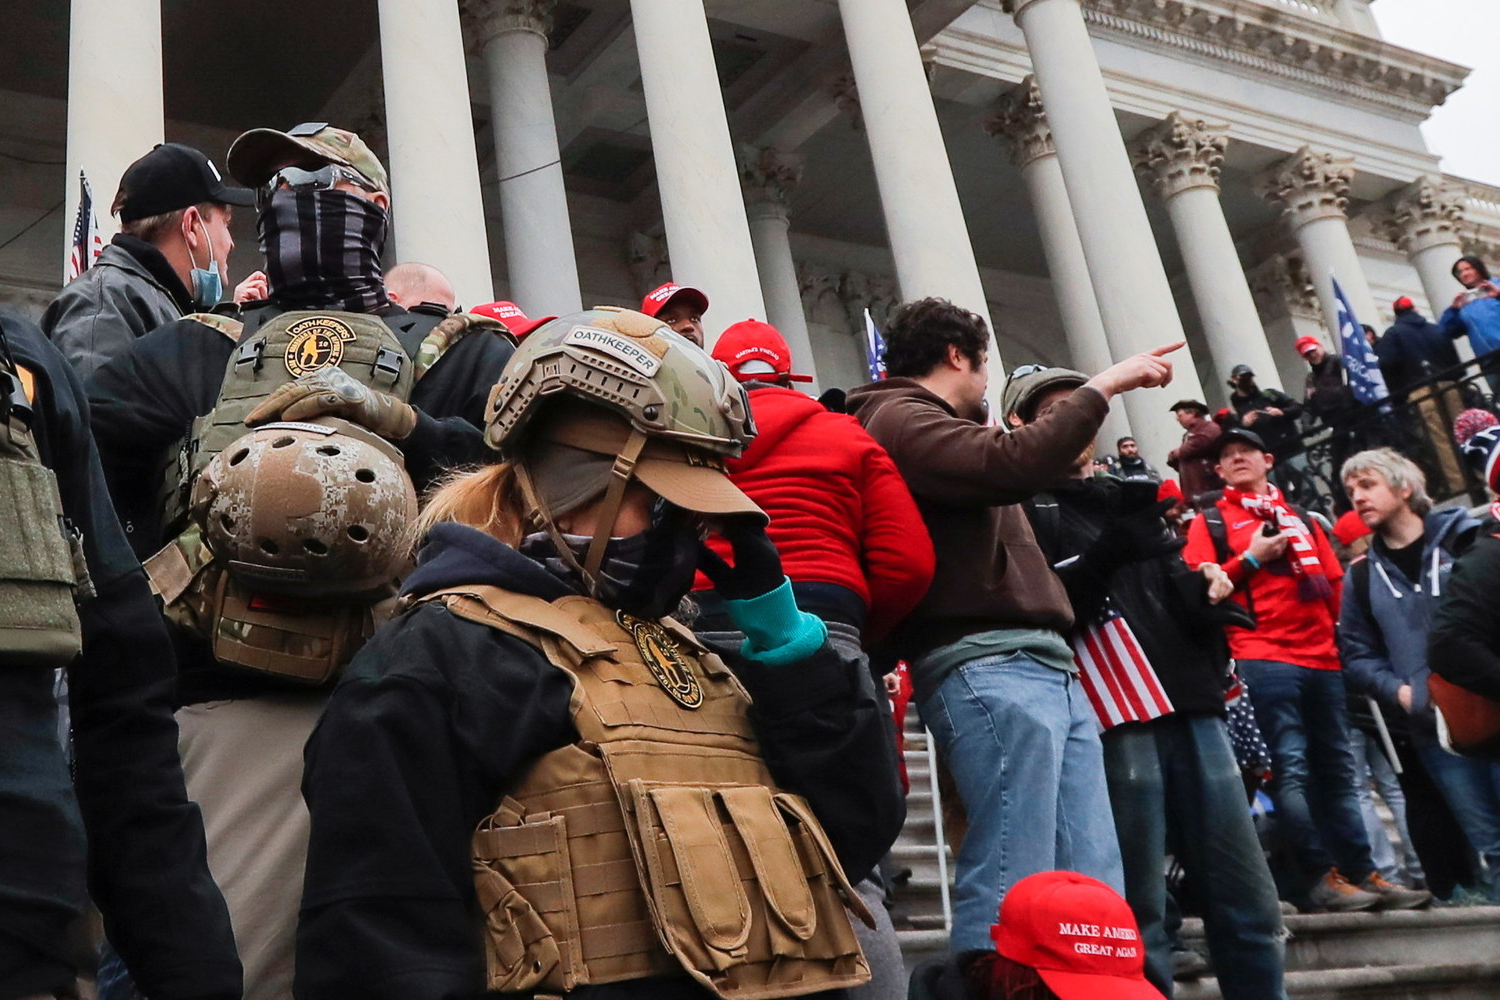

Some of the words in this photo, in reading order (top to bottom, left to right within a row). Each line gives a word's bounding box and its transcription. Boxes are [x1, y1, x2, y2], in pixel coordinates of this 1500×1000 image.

[574, 330, 654, 369] OATHKEEPER
[1059, 923, 1100, 937] MAKE
[1074, 942, 1113, 956] GREAT
